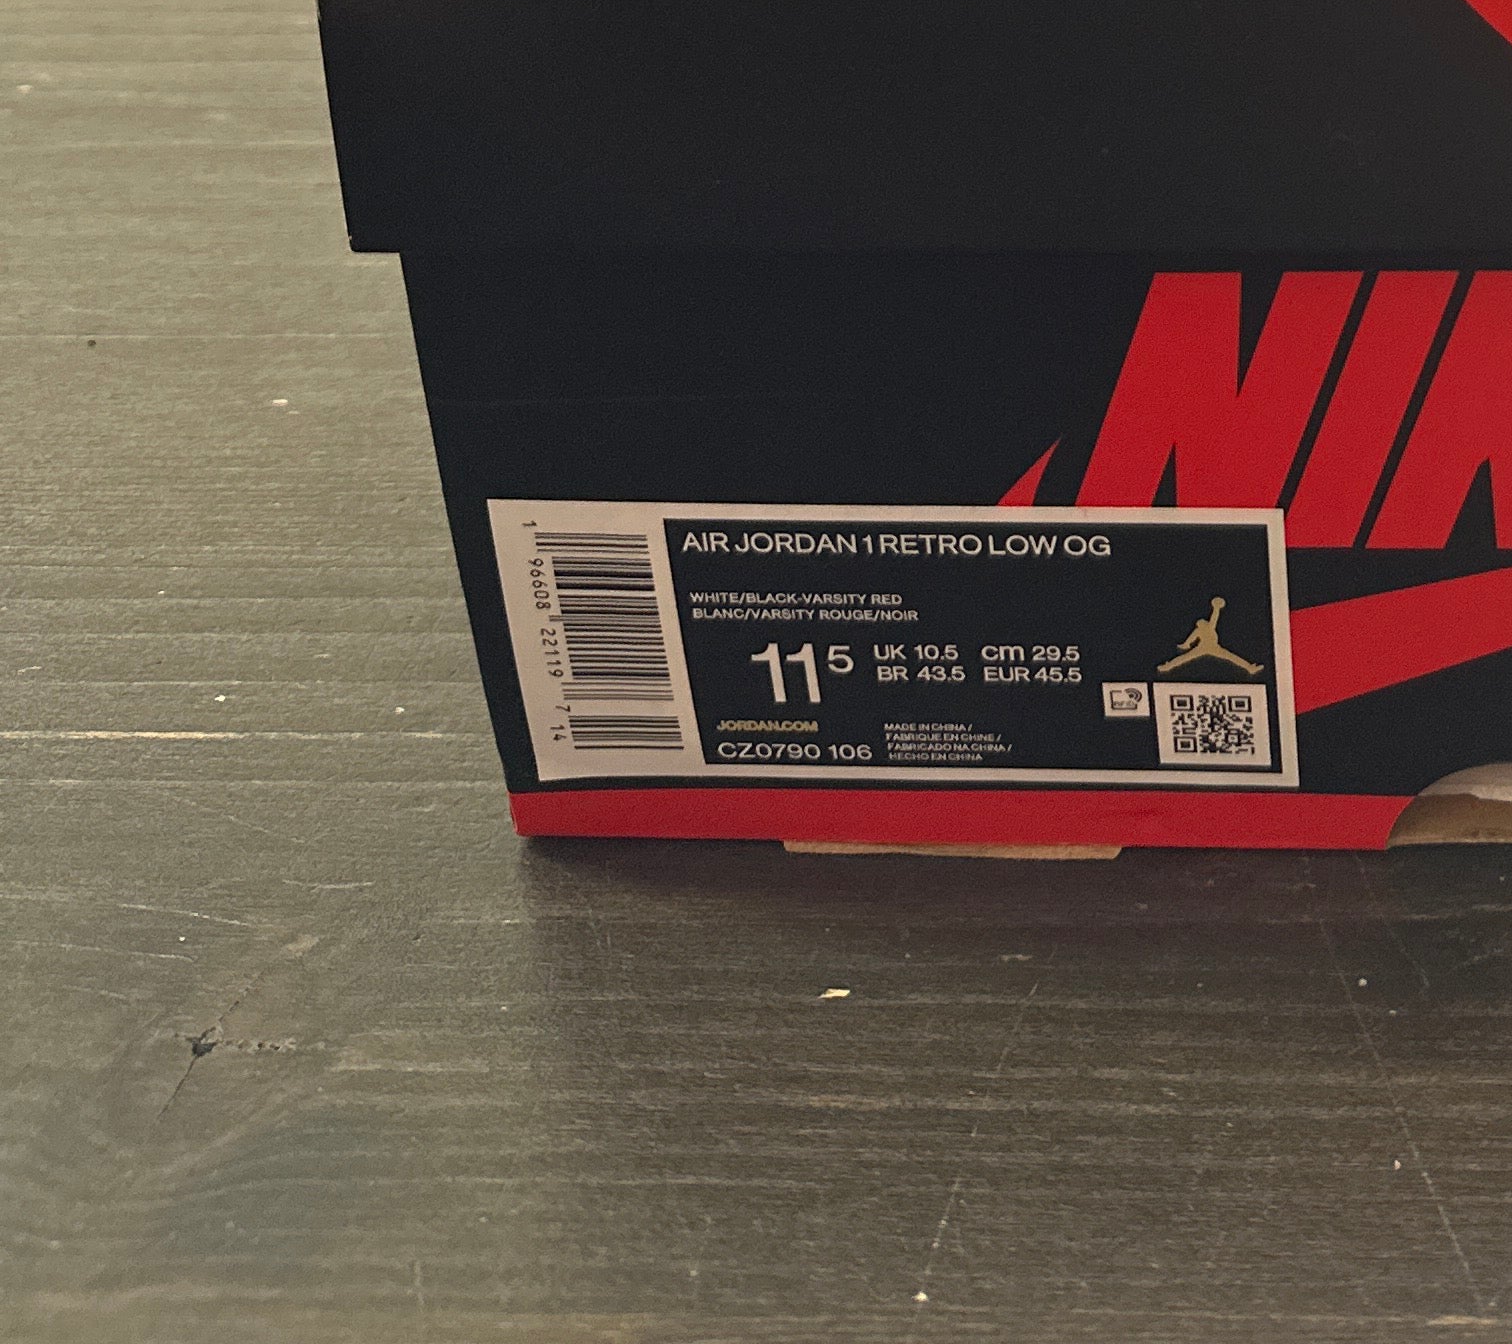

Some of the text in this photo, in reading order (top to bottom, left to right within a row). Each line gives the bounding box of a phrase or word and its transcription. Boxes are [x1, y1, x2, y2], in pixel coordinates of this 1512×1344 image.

[683, 532, 1112, 556] AIR JORDAN 1 RETRO LOW OG
[690, 592, 902, 605] WHITE/BLACK-VARSITY RED
[528, 558, 551, 609] 96608
[541, 628, 564, 678] 22119
[693, 608, 919, 622] BLANC/VARSITY ROUGE/NOIR
[873, 644, 1080, 662] UK 10.5 cm 29.5
[877, 666, 1082, 683] BR 43.5 EUR 45.5
[717, 720, 818, 732] JORDAN.COM
[884, 723, 916, 731] MADE
[919, 723, 930, 731] IN
[886, 733, 942, 742] FABRIQUE
[944, 734, 959, 742] EN
[717, 742, 873, 760] CZ0790 106
[887, 743, 951, 751] FABRICADO
[953, 743, 970, 751] NA
[948, 753, 982, 761] CHINA
